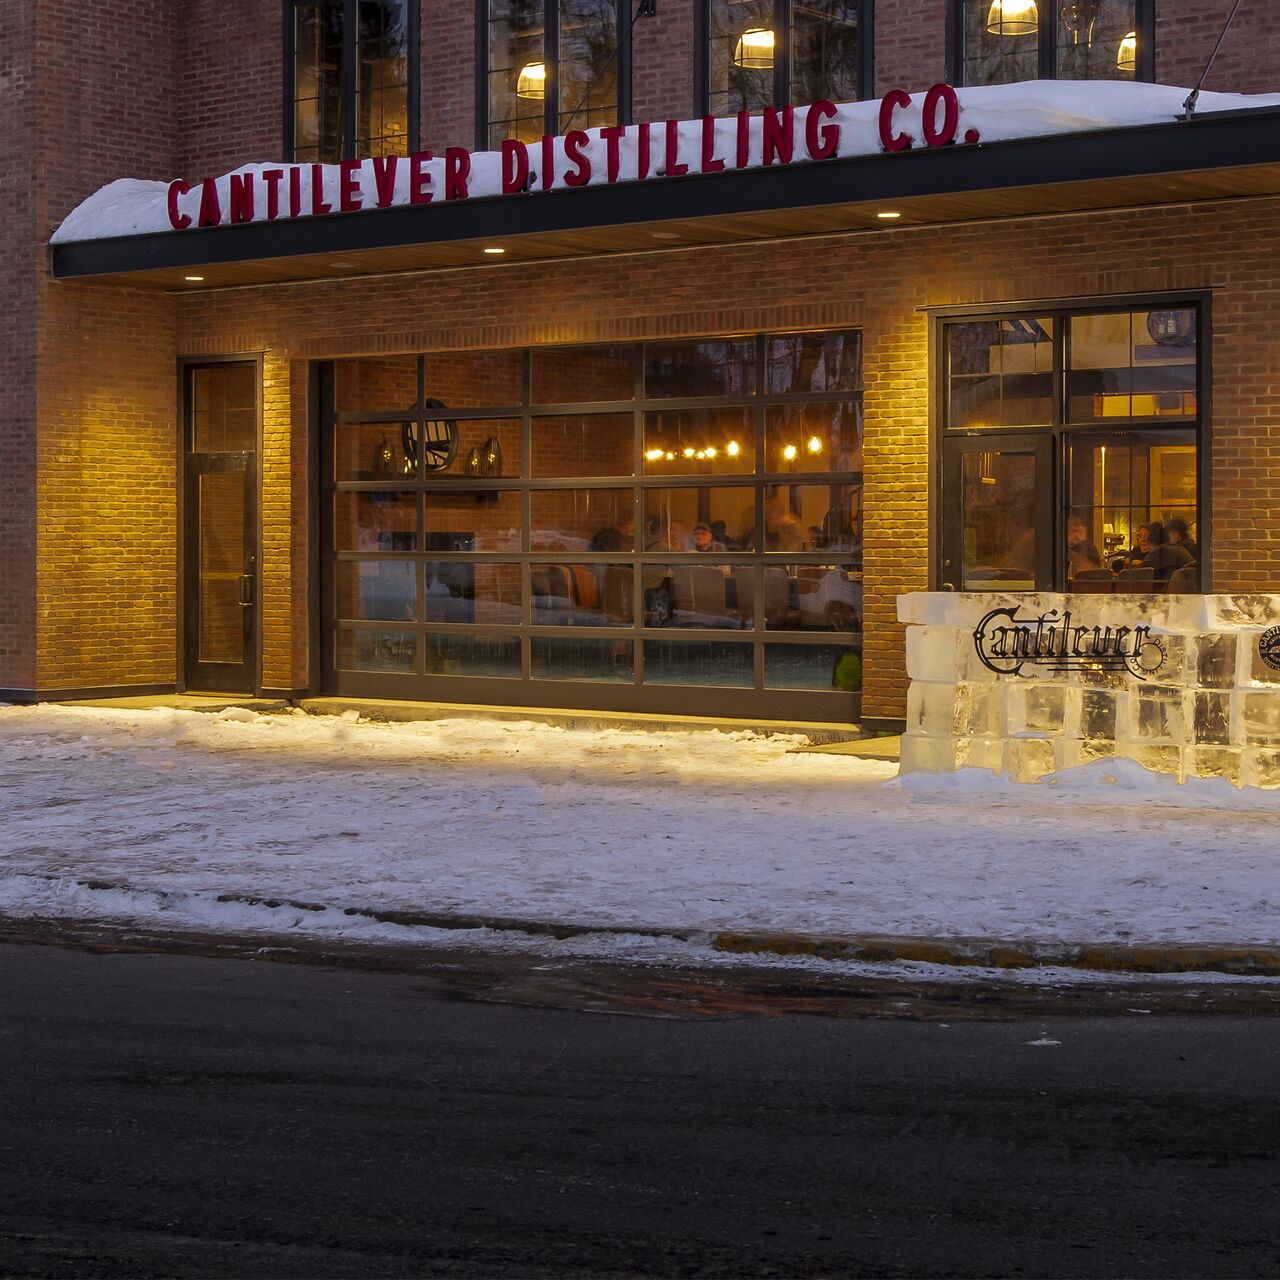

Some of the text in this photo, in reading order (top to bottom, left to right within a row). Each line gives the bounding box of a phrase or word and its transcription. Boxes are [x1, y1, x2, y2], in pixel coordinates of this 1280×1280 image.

[167, 83, 981, 230] CANTILEVER DISTILLING CO.
[973, 604, 1151, 676] Cantilever
